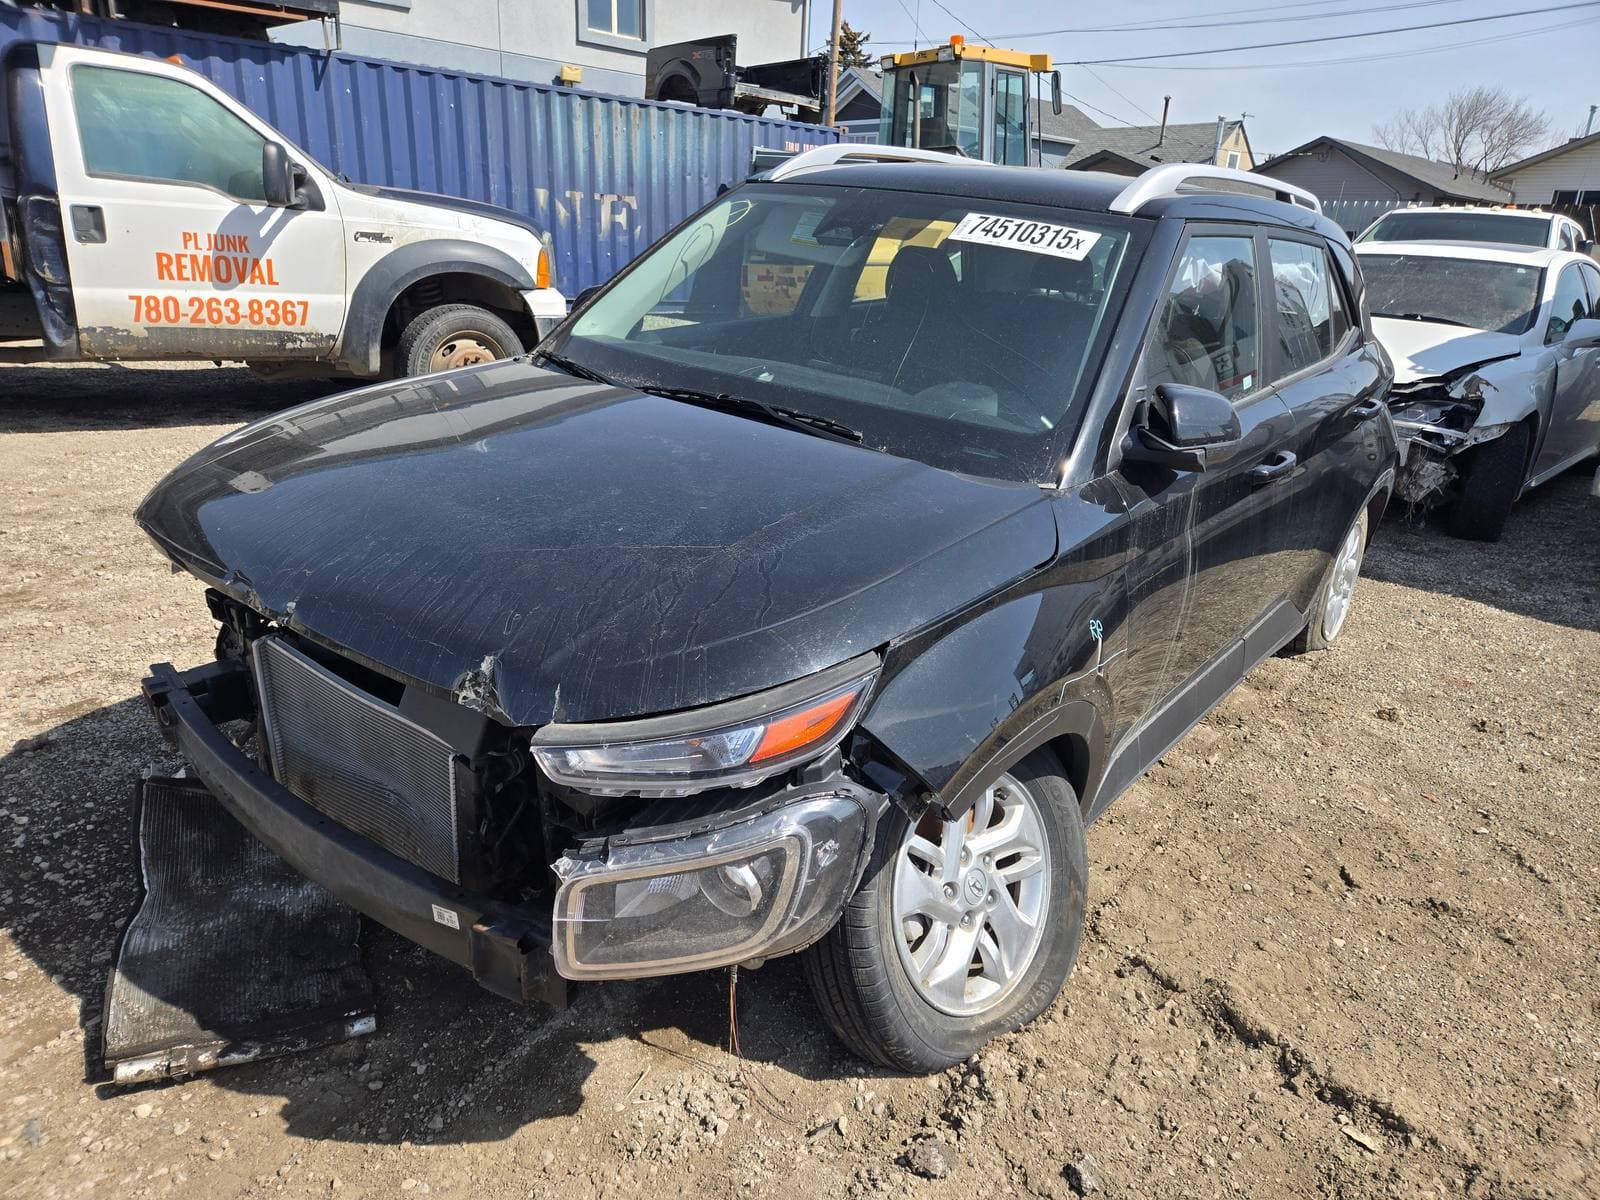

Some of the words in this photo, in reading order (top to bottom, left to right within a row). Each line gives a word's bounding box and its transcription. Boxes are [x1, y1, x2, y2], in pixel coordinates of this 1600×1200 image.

[182, 231, 203, 251] PL
[206, 233, 250, 253] JUNK
[155, 251, 280, 286] REMOVAL
[128, 295, 309, 326] 780-263-8367
